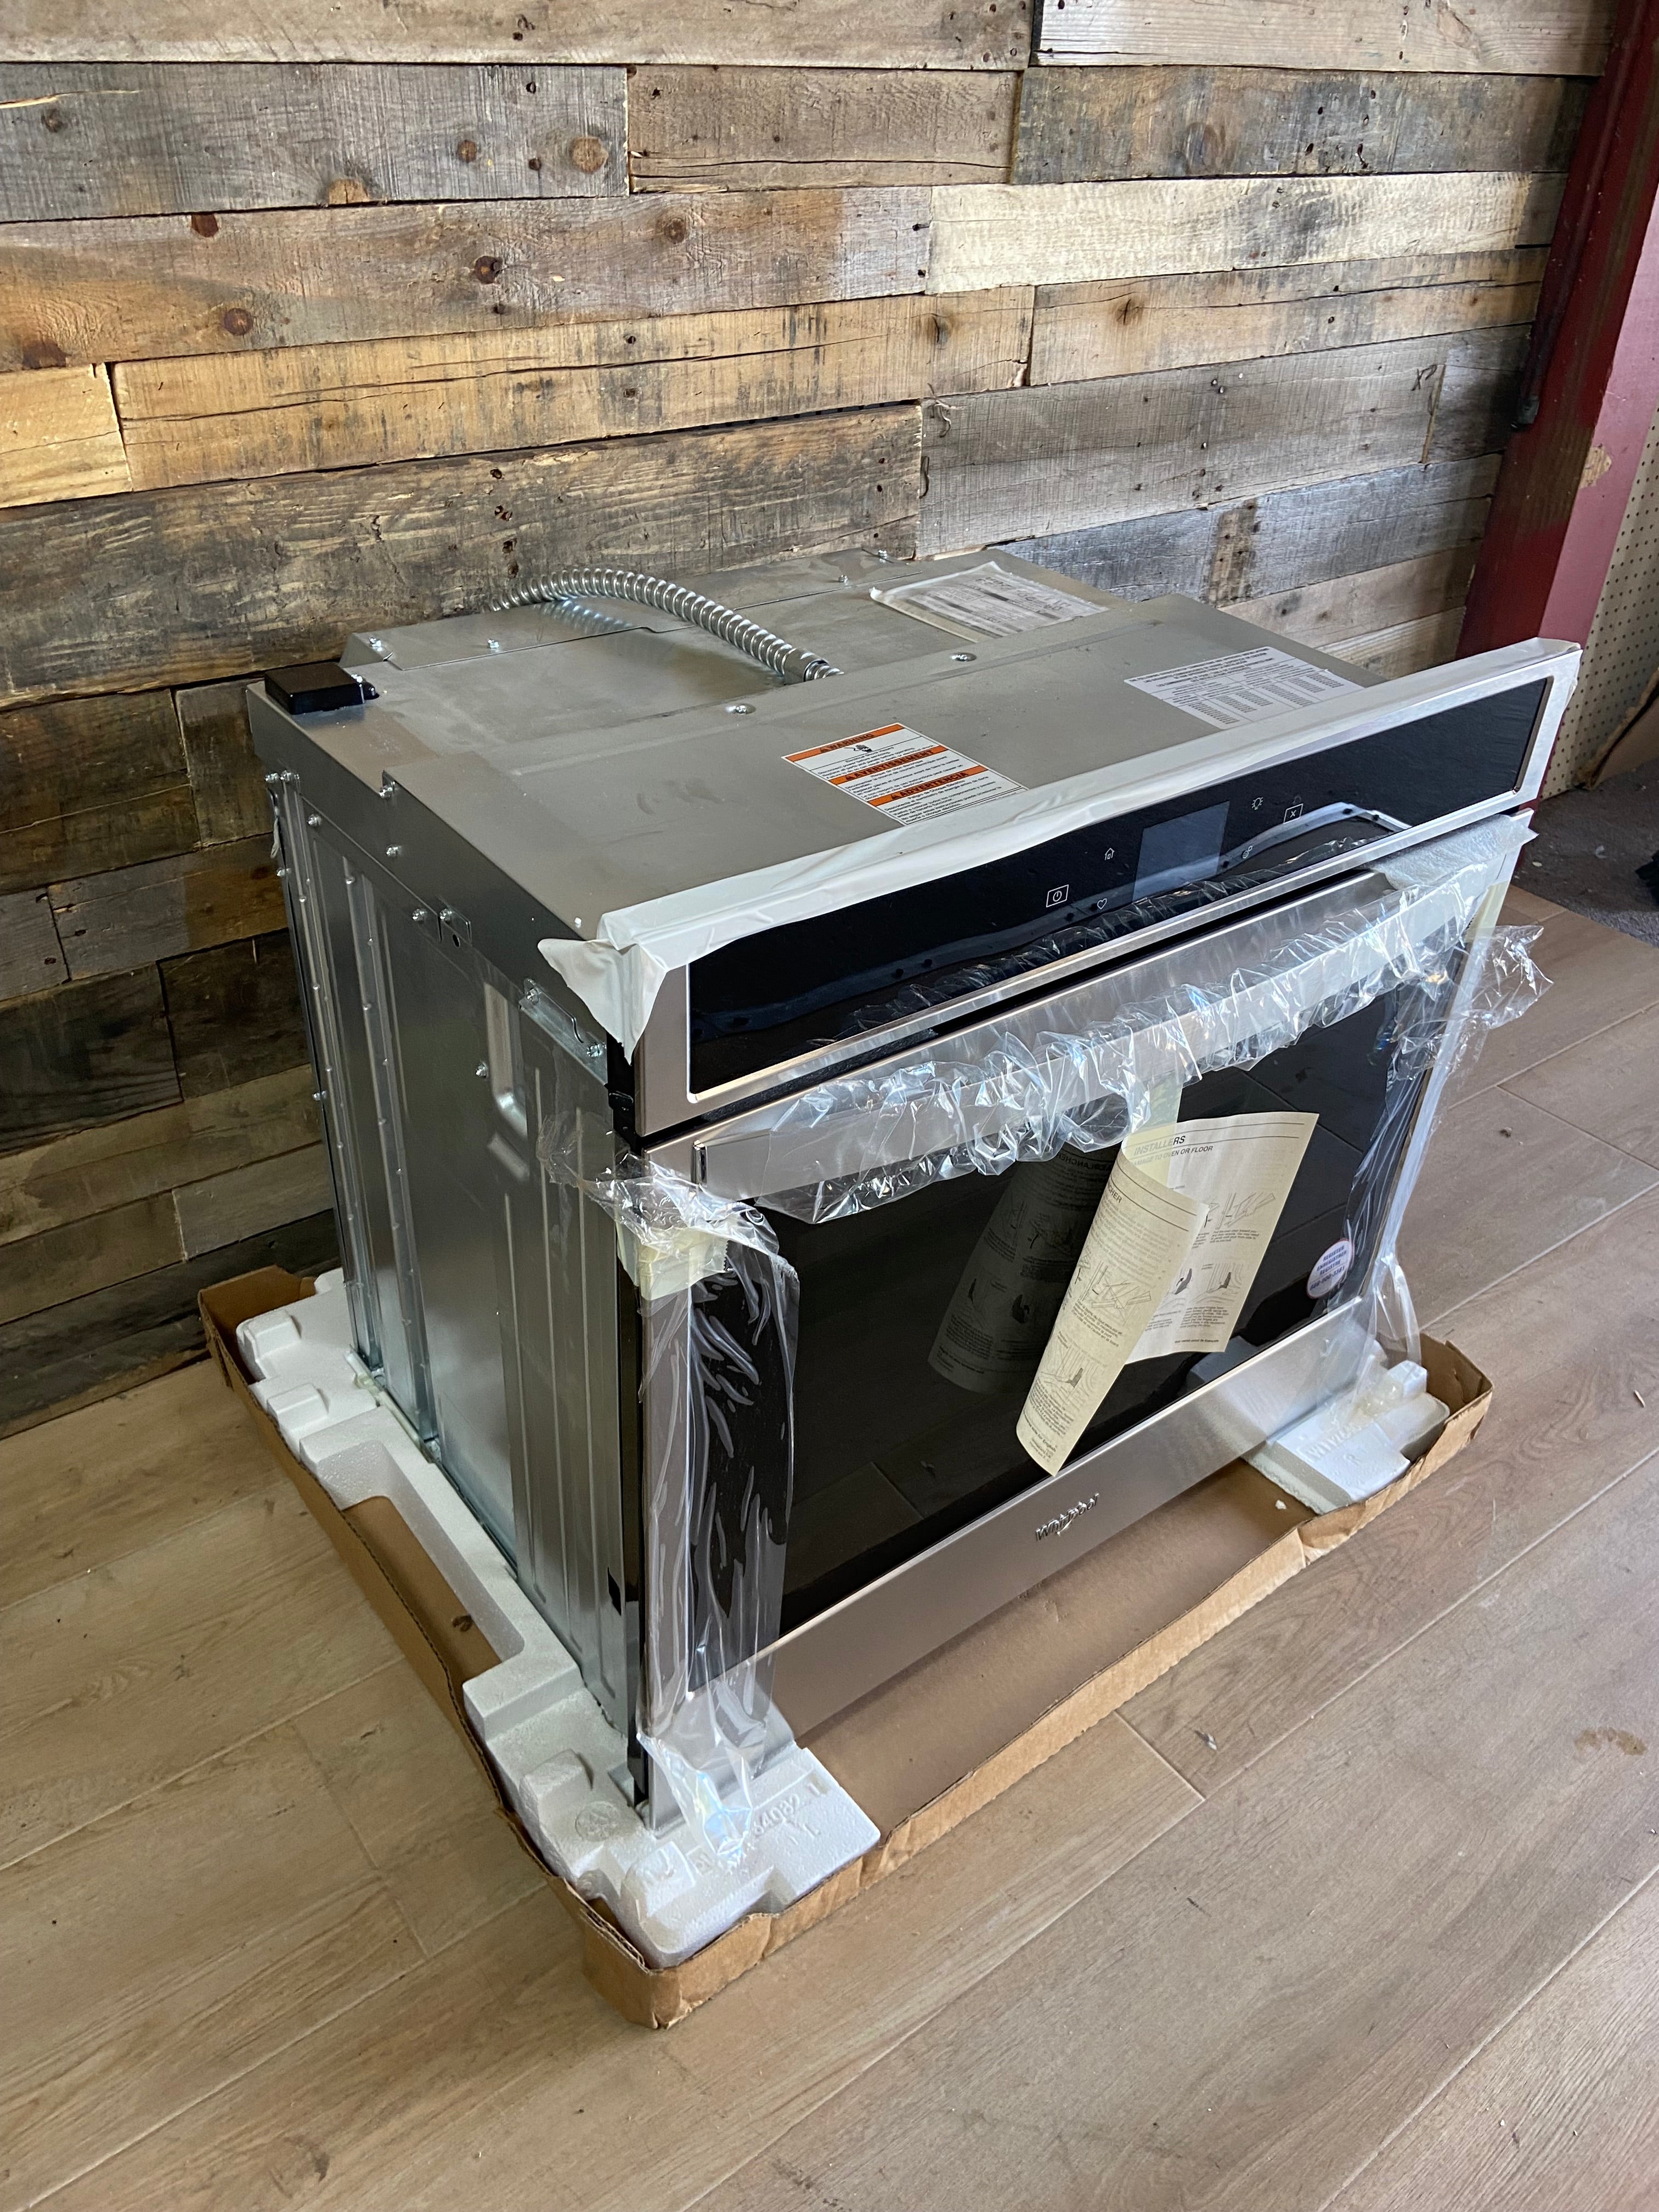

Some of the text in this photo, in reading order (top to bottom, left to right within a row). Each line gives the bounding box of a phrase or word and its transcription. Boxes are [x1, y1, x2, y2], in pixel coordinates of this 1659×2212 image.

[830, 734, 874, 749] WARNING
[854, 750, 934, 777] AVERTISSEMENT
[899, 772, 968, 797] ADVERTENCIA
[1132, 1156, 1154, 1165] AMAGE
[1163, 1150, 1180, 1158] OVEN
[1191, 1145, 1214, 1153] FLOOR
[1134, 1135, 1186, 1156] INSTALLERS
